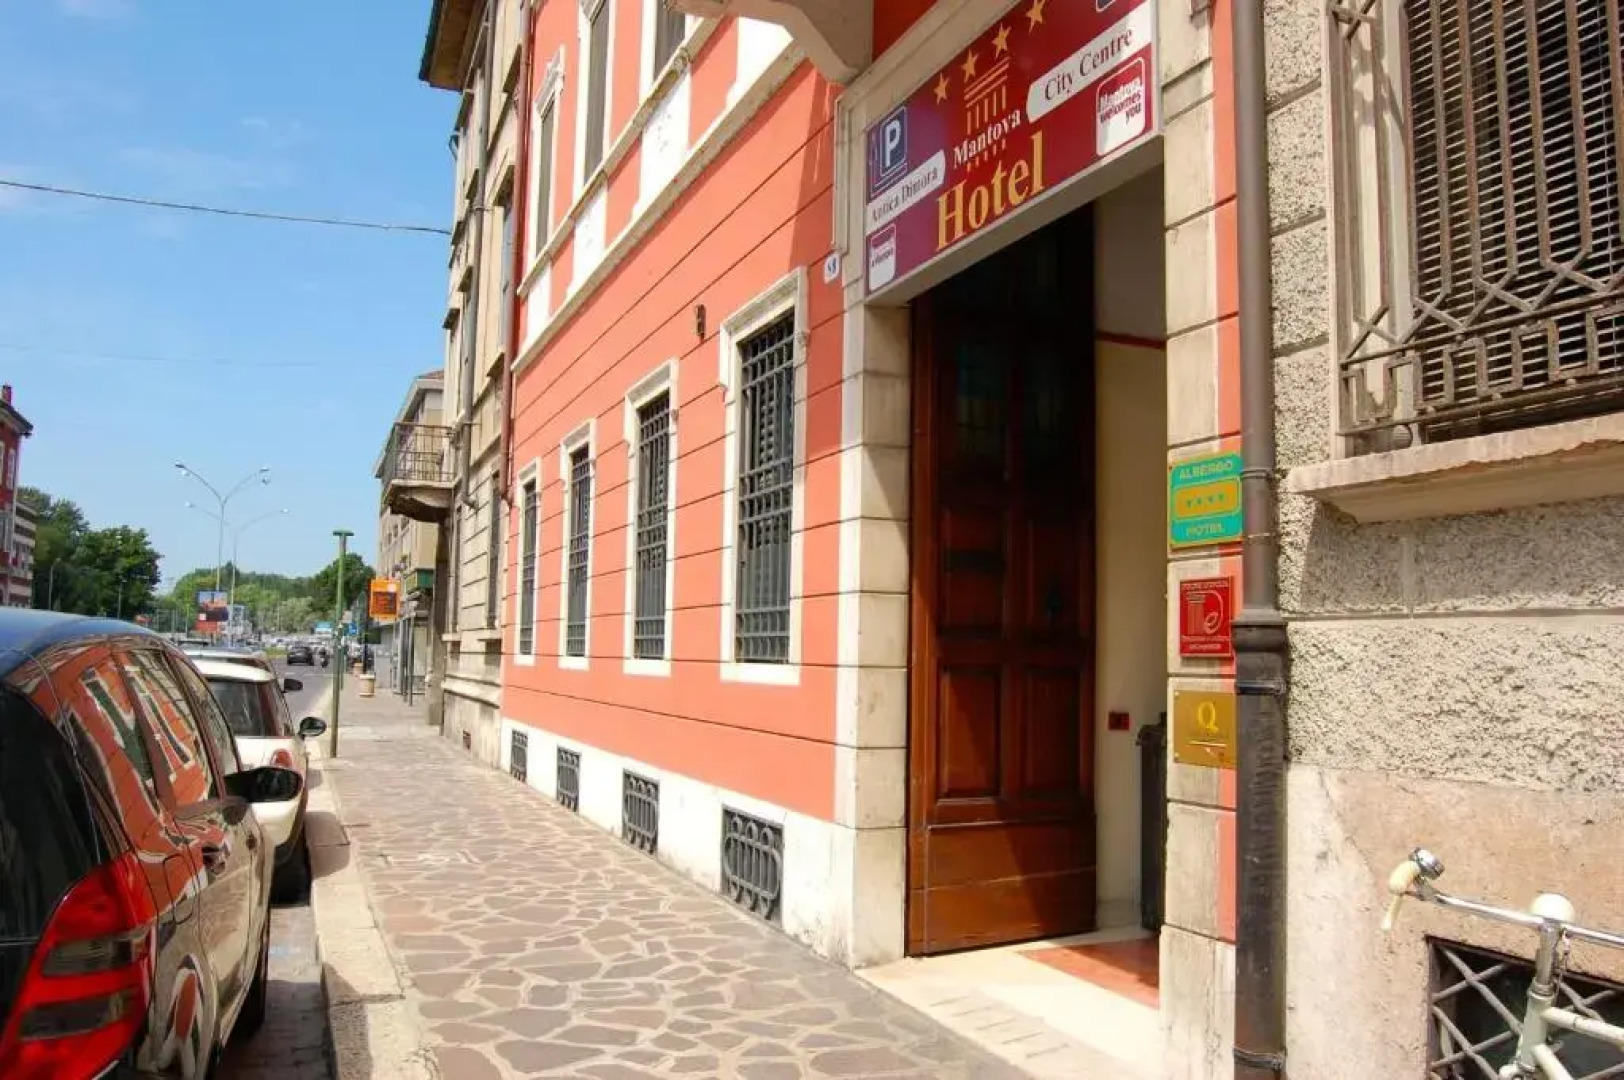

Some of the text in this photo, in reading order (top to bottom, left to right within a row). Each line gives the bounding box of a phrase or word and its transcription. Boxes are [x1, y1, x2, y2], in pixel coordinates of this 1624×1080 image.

[1044, 28, 1133, 102] City Centre
[953, 109, 1021, 167] Mantova
[1125, 102, 1141, 126] you
[885, 120, 901, 167] P
[935, 130, 1043, 250] Hotel
[1197, 701, 1219, 734] Q
